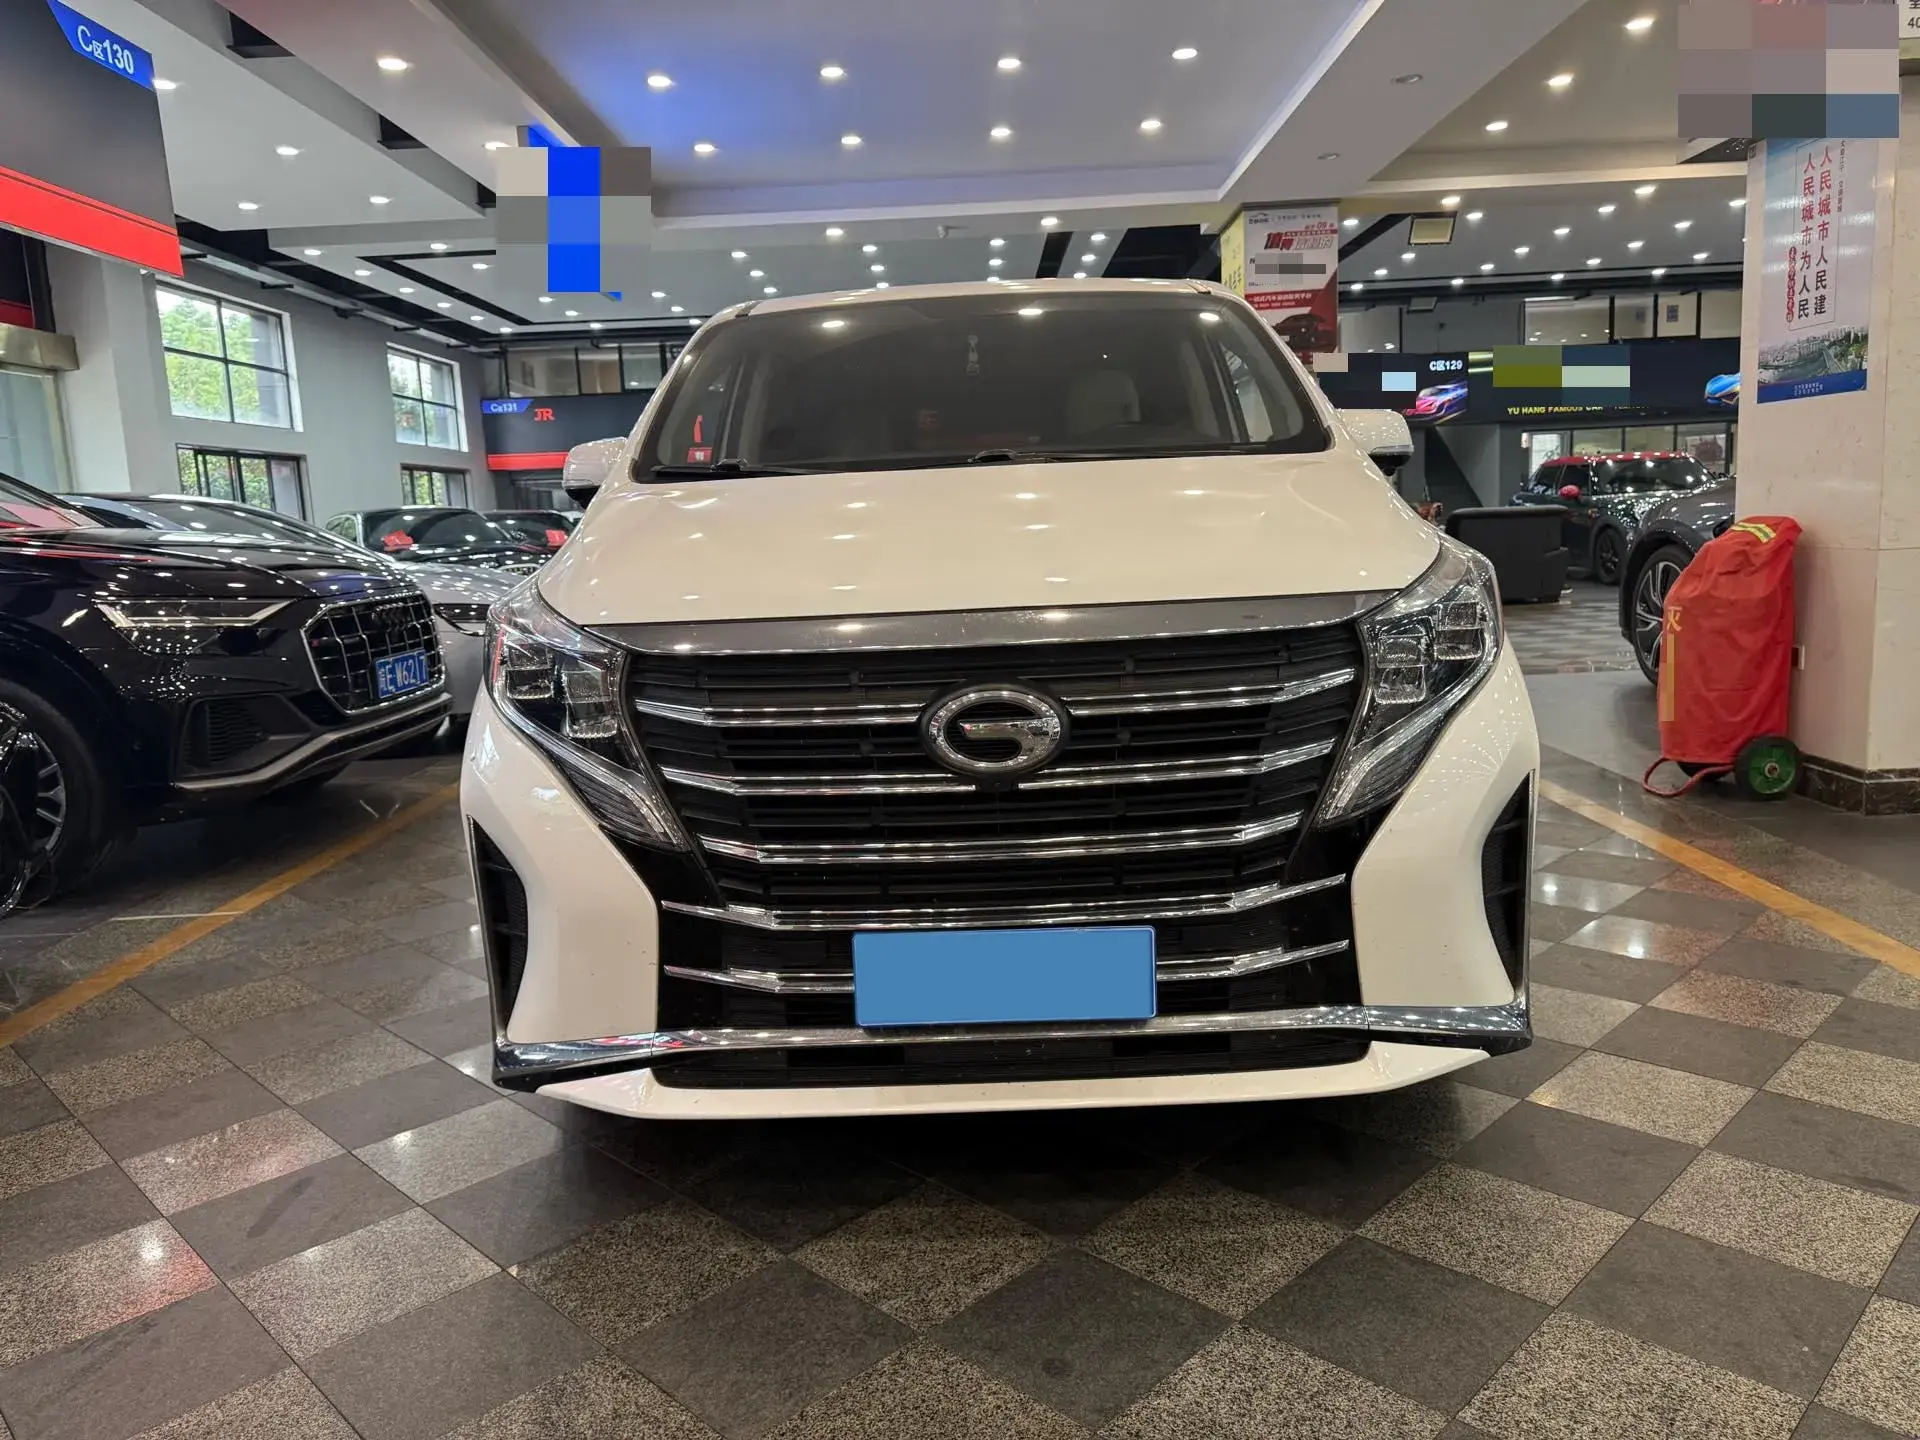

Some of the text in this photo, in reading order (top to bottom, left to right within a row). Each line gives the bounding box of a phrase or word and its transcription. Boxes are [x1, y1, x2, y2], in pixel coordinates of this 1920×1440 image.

[77, 25, 134, 75] C区130
[1797, 152, 1816, 320] 人民城市为人民
[1813, 145, 1833, 316] 人民城市人民建
[534, 408, 555, 421] JR
[1507, 406, 1520, 415] YU
[1521, 406, 1546, 414] HANG
